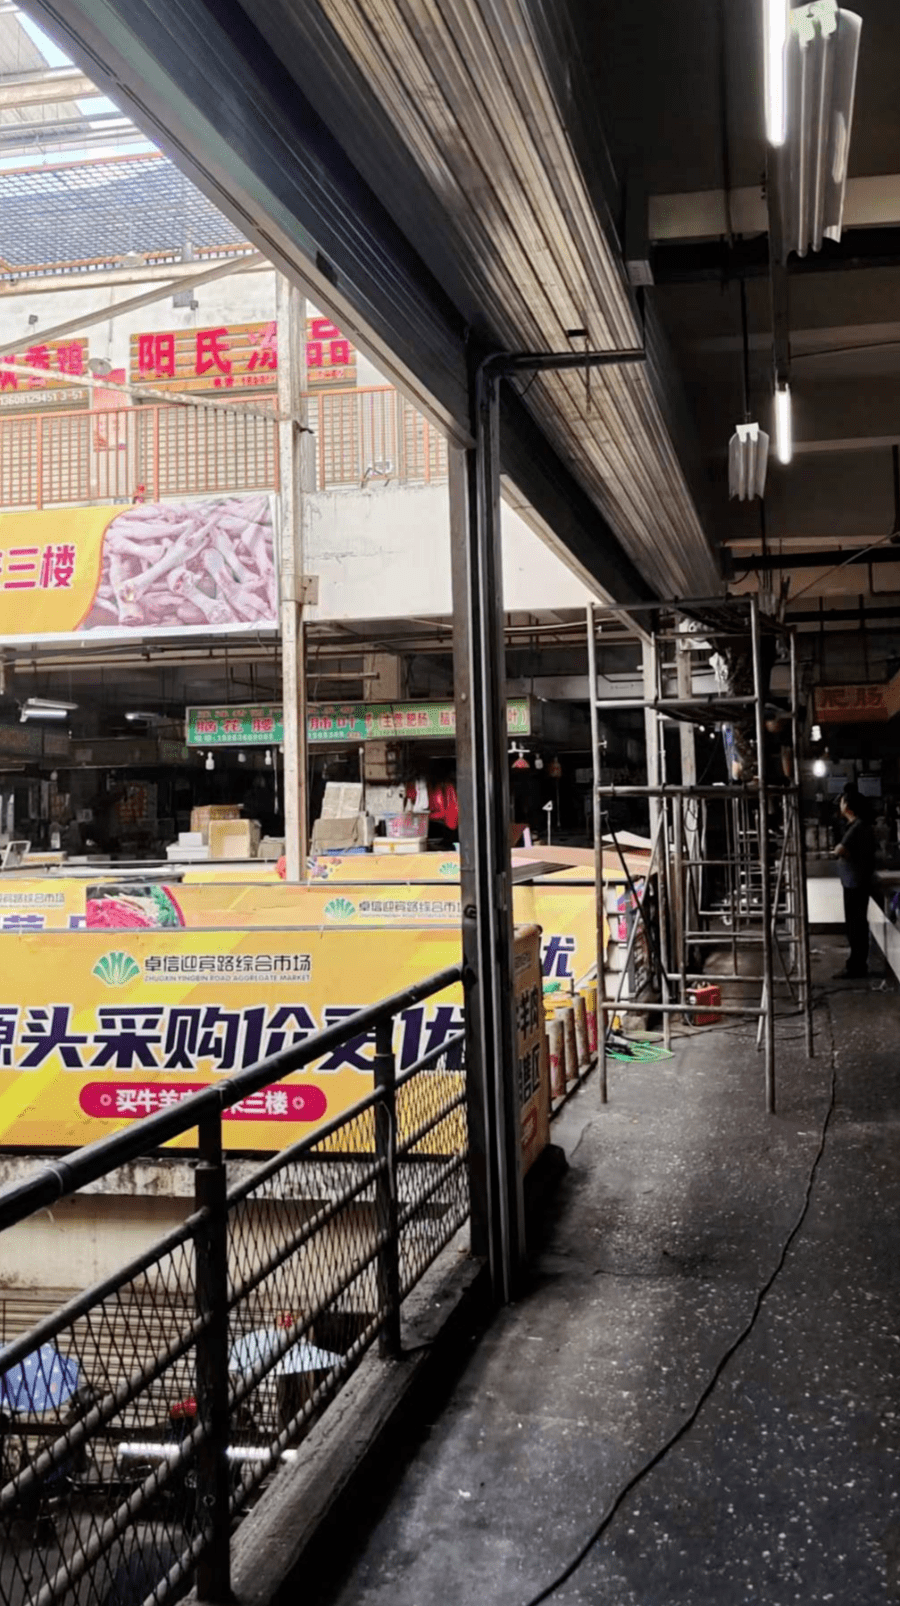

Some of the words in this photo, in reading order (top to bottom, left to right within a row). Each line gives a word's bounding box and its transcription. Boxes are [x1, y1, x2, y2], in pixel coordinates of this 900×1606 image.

[0, 545, 75, 589] 三楼
[145, 954, 311, 972] 卓信迎宾路综合市场
